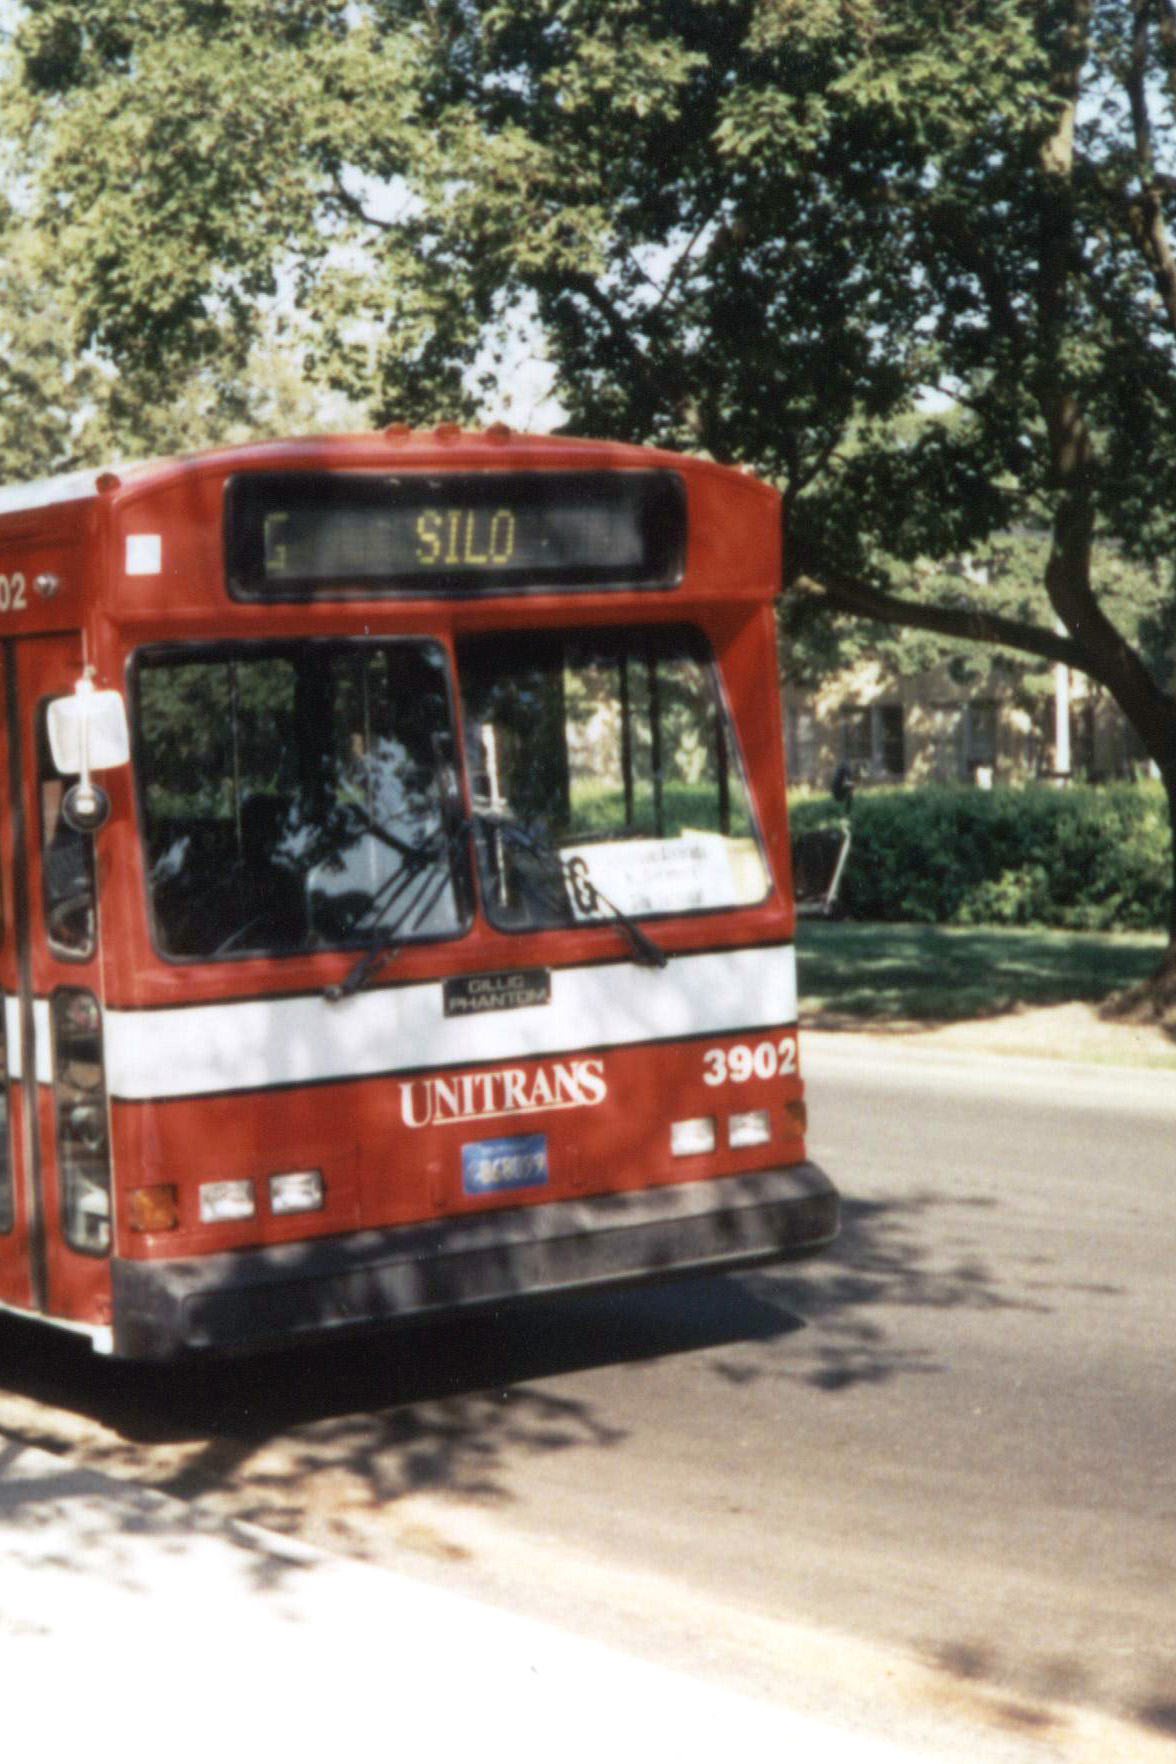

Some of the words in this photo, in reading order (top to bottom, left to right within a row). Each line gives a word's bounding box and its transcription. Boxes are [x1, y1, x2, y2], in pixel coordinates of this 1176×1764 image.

[414, 508, 516, 565] SILO
[449, 987, 547, 1011] PHANTOM
[468, 975, 524, 994] GILLIG
[702, 1037, 798, 1087] 3902
[399, 1058, 608, 1130] UNITRANS
